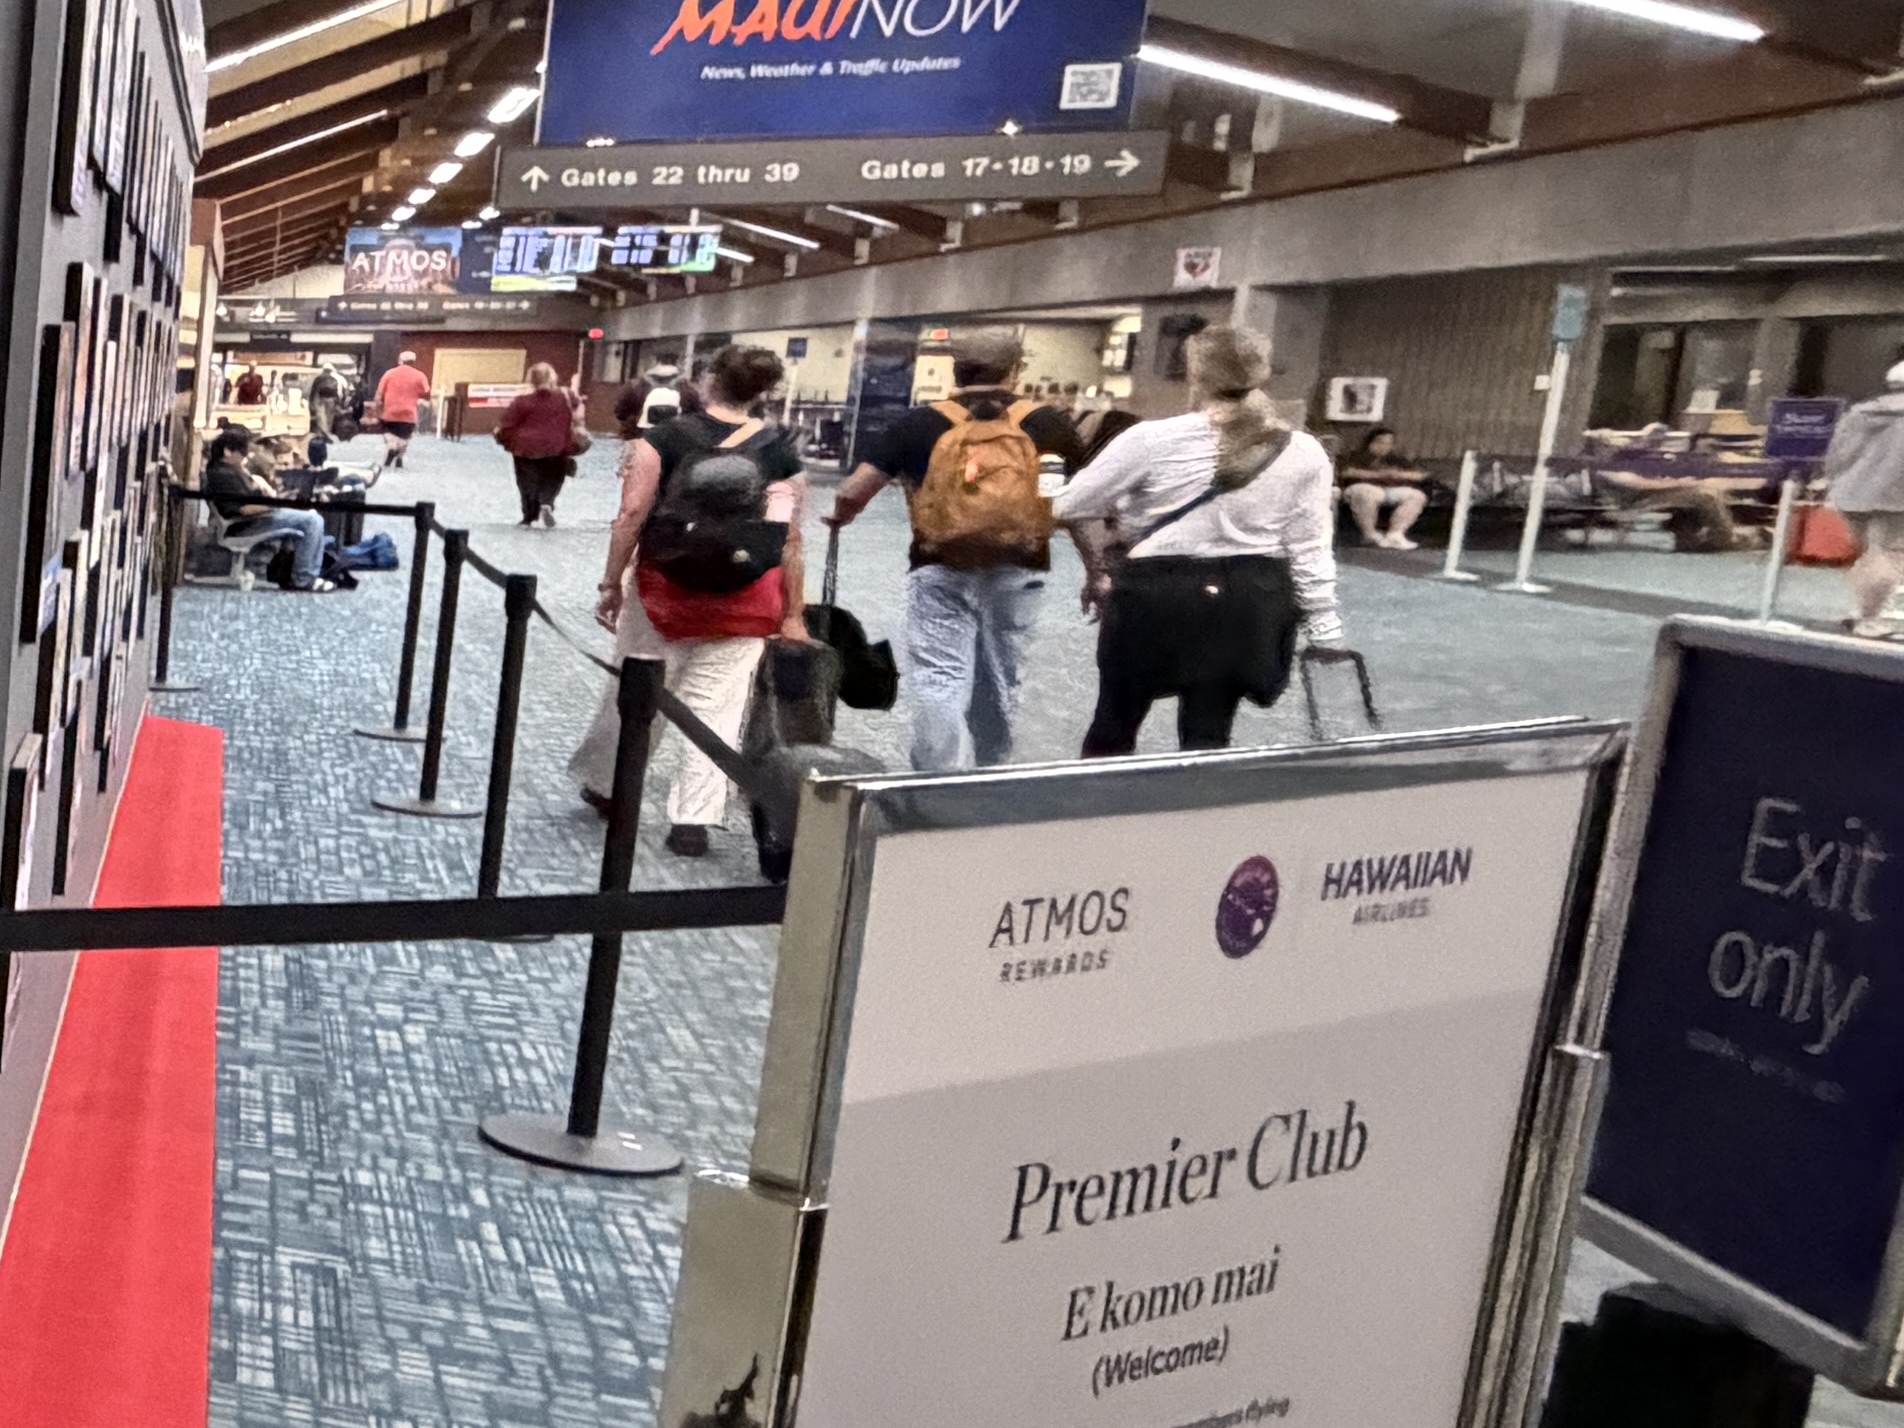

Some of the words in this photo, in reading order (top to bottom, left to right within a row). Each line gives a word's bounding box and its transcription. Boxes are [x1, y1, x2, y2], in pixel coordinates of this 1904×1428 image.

[819, 60, 833, 77] &
[560, 167, 639, 188] Gates
[651, 165, 685, 186] 22
[696, 164, 752, 185] thru
[763, 162, 800, 183] 39
[860, 158, 946, 180] Gates
[351, 249, 448, 272] ATMOS
[1320, 846, 1474, 901] HAWAIIAN
[1740, 796, 1892, 922] Exit
[987, 886, 1130, 949] ATMOS
[997, 949, 1110, 983] REWARDS
[1707, 928, 1870, 1056] only
[1001, 1136, 1238, 1244] Premier
[1247, 1099, 1369, 1191] Club
[1060, 1285, 1097, 1342] E
[1099, 1275, 1205, 1334] komo
[1210, 1243, 1282, 1305] mai
[1091, 1323, 1231, 1400] (Welcome)
